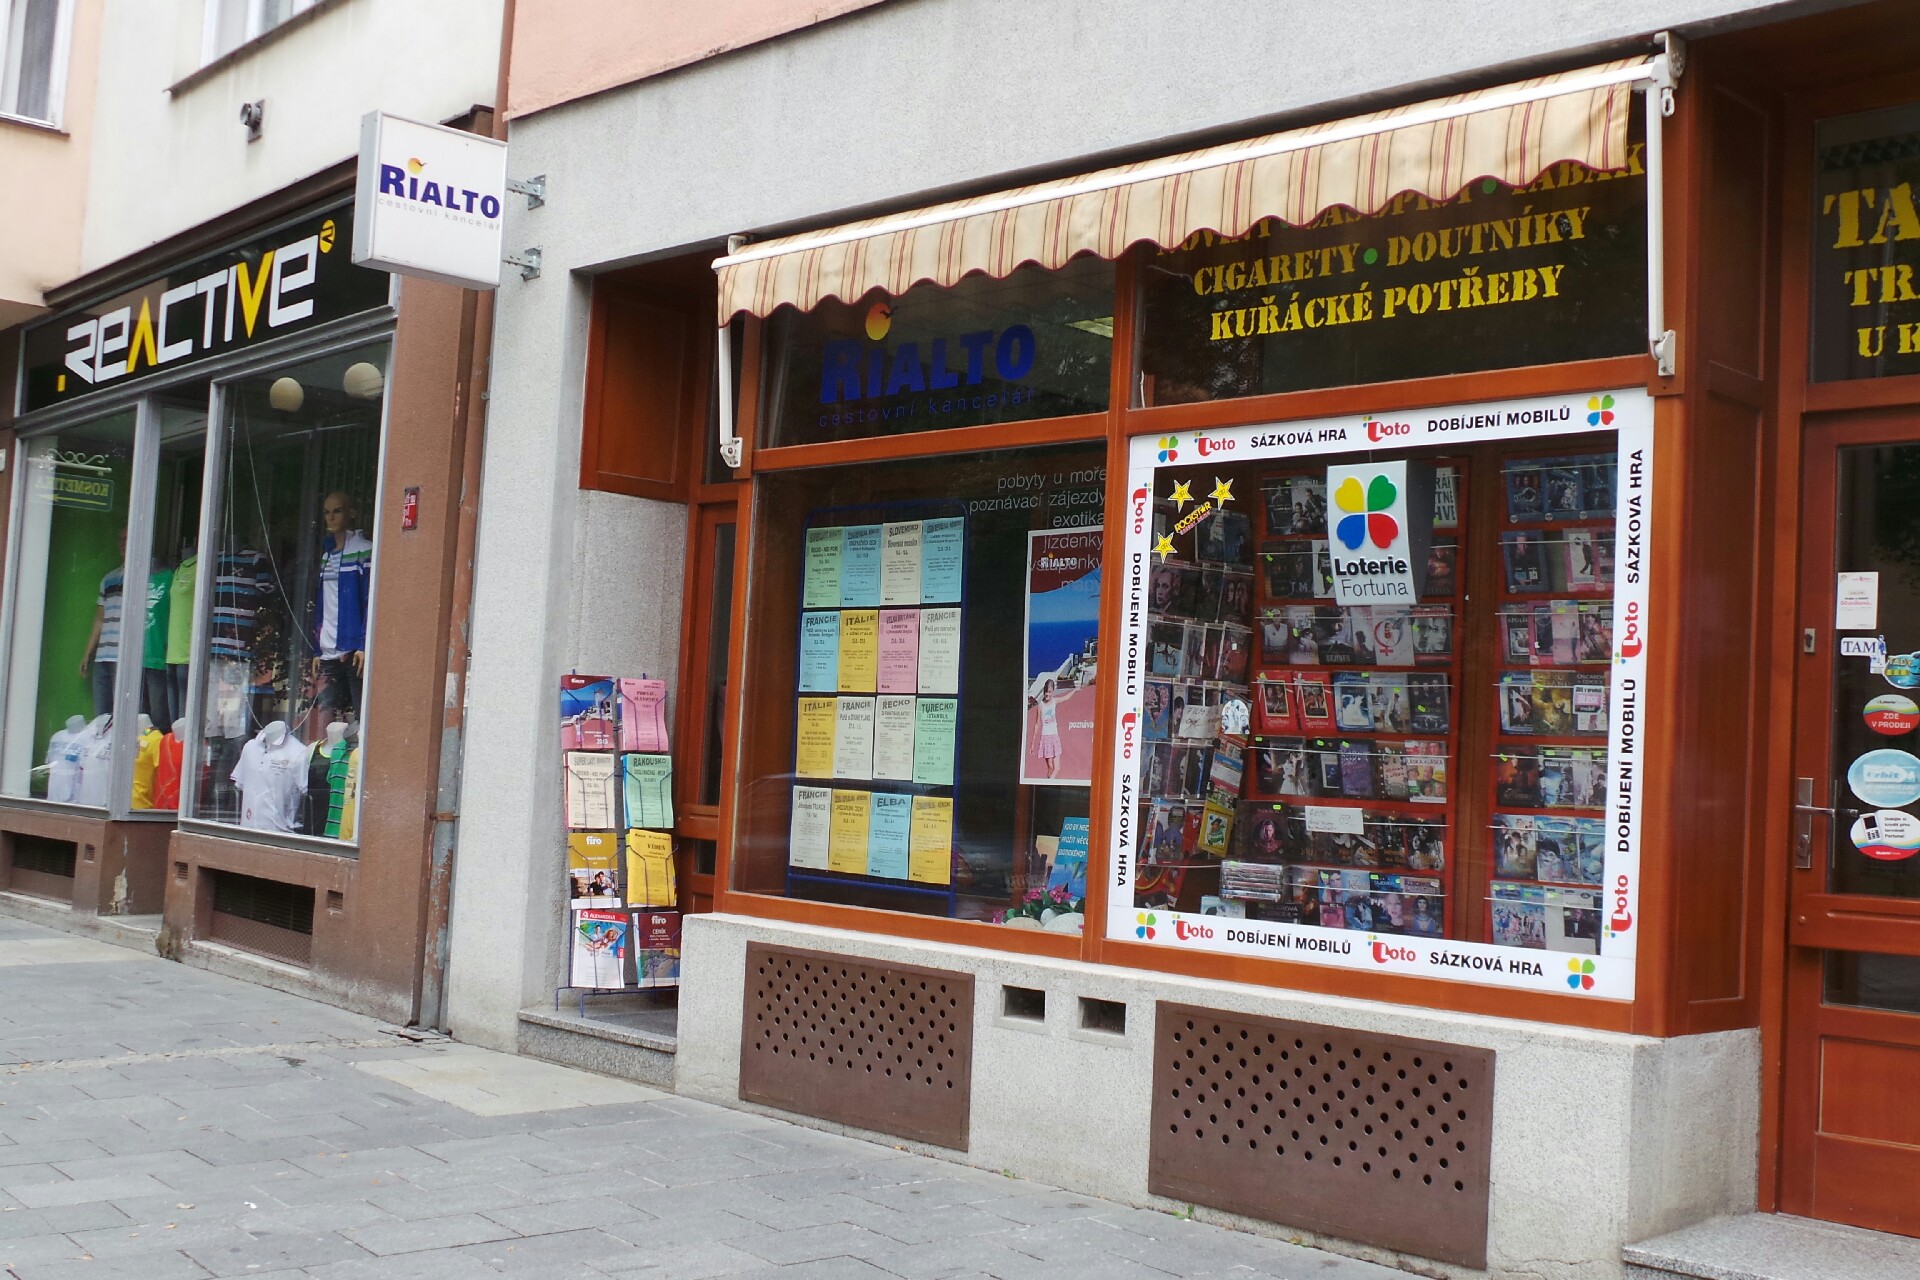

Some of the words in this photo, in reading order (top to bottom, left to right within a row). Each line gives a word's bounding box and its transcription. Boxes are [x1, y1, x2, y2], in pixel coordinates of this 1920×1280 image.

[379, 163, 500, 219] RIALTO
[1194, 242, 1360, 297] CIGARETY
[1386, 205, 1592, 267] DOUTNÍKY
[1210, 282, 1374, 341] KUŘÁCKÉ
[1382, 265, 1566, 318] POTŘEBY
[820, 324, 1036, 404] RIALTO
[818, 404, 916, 428] cestovní
[928, 385, 1036, 415] kancelář
[1197, 437, 1236, 457] Loto
[1250, 428, 1314, 449] SÁZKOVÁ
[1318, 428, 1348, 443] HRA
[1367, 420, 1411, 443] Loto
[1427, 411, 1502, 432] DOBÍJENÍ
[1506, 404, 1571, 427] MOBILŮ
[997, 472, 1046, 493] pobyty
[1053, 473, 1063, 485] u
[1069, 466, 1107, 484] moře
[1629, 448, 1644, 489] HRA
[969, 492, 1044, 516] poznávací
[1049, 488, 1106, 510] zájezdy
[1052, 510, 1105, 528] exotika
[1042, 532, 1104, 554] jízdenky
[1625, 495, 1643, 584] SÁZKOVÁ
[1334, 555, 1408, 576] Loterie
[1129, 552, 1142, 628] DOBÍJENÍ
[1340, 578, 1409, 598] Fortuna
[805, 615, 837, 627] FRANCIE
[846, 614, 876, 626] ITÁLIE
[926, 611, 956, 623] FRANCIE
[1843, 641, 1876, 653] TAM
[1126, 633, 1138, 695] MOBILŮ
[804, 701, 833, 712] ITÁLIE
[842, 701, 871, 711] FRANCIE
[882, 699, 911, 710] ŘECKO
[921, 702, 954, 714] TURECKO
[1620, 678, 1637, 754] MOBILŮ
[1878, 721, 1911, 729] PRODEJI
[633, 757, 666, 768] RAKOUSKO
[798, 790, 828, 801] FRANCIE
[876, 797, 906, 808] ELBA
[1617, 760, 1632, 853] DOBÍJENÍ
[1118, 774, 1131, 848] SÁZKOVÁ
[586, 835, 602, 845] firo
[1117, 854, 1128, 887] HRA
[651, 915, 667, 925] firo
[1176, 920, 1213, 941] Loto
[1226, 929, 1291, 949] DOBÍJENÍ
[1295, 937, 1351, 955] MOBILŮ
[1372, 941, 1416, 964] Loto
[1429, 949, 1504, 973] SÁZKOVÁ
[1509, 960, 1543, 977] HRA
